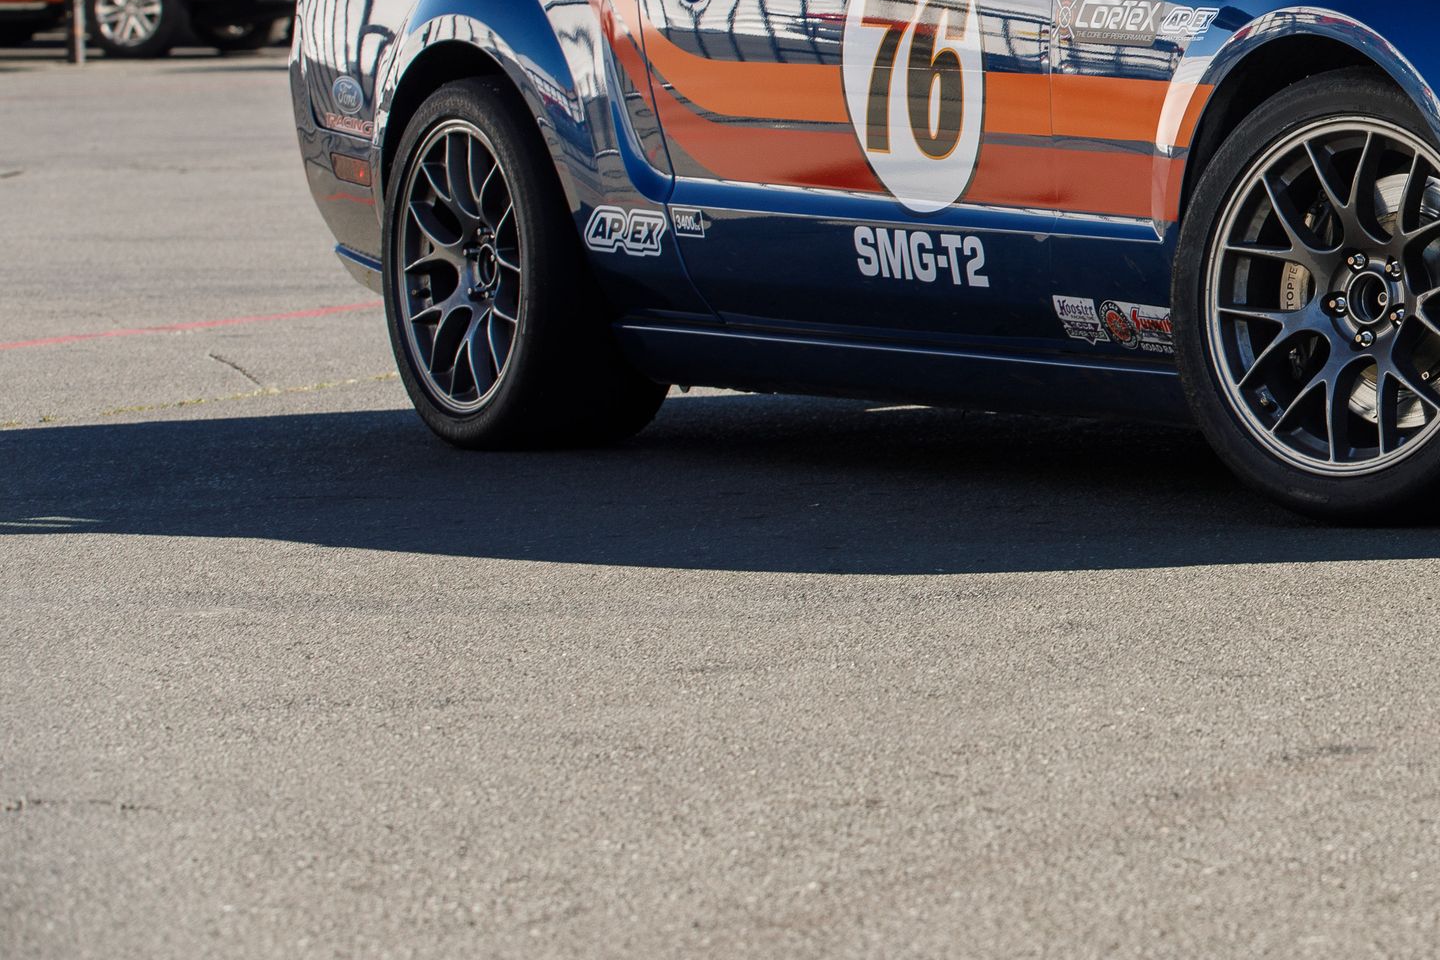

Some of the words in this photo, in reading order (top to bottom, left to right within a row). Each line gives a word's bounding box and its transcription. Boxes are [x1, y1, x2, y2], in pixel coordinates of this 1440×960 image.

[1164, 9, 1218, 32] APEX
[1109, 33, 1154, 41] PERFORMANCE
[338, 82, 358, 106] Ford
[325, 112, 374, 137] RACING
[588, 211, 663, 251] APEX
[854, 226, 989, 287] SMG-T2
[1057, 300, 1095, 318] Hoosier
[1141, 343, 1163, 352] ROAD
